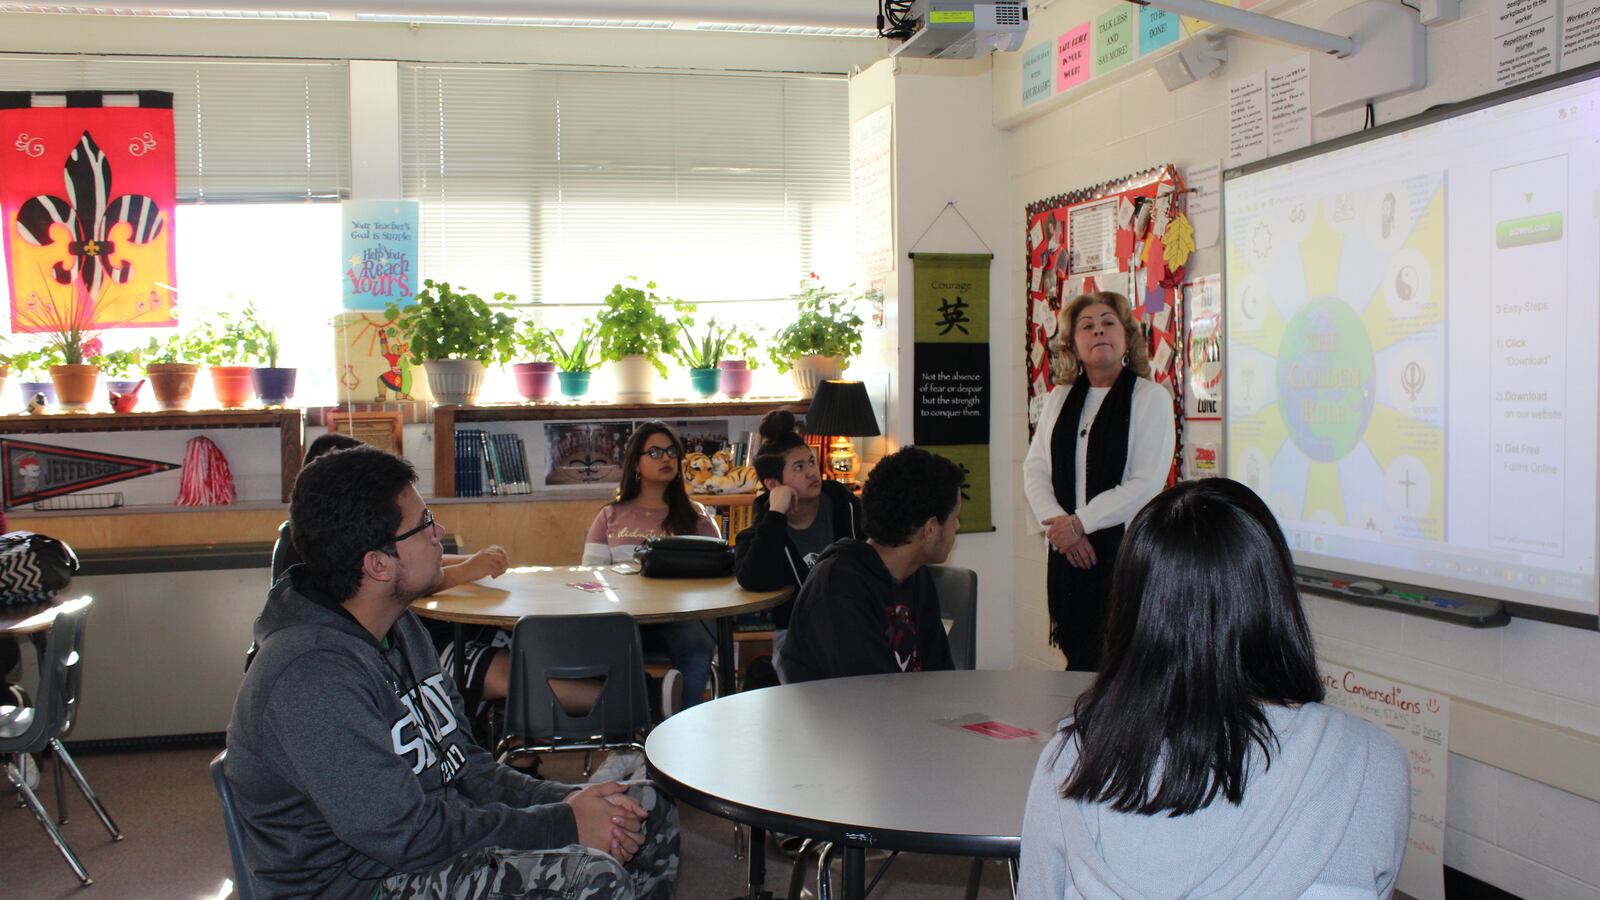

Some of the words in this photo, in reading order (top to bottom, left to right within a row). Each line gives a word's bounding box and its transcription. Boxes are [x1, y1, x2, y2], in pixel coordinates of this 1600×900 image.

[1150, 12, 1158, 22] TO
[1158, 8, 1167, 18] BE
[1515, 14, 1533, 24] worker
[1098, 21, 1113, 34] TALK
[1113, 12, 1128, 27] LESS
[1106, 33, 1119, 46] AND
[1098, 53, 1109, 65] SAY
[351, 231, 370, 239] Goal
[361, 256, 408, 279] Reach
[931, 280, 972, 293] Courage
[1503, 303, 1522, 315] Easy
[935, 296, 970, 336] 英
[1505, 338, 1526, 348] Click
[922, 373, 936, 381] Not
[937, 371, 950, 381] the
[951, 371, 980, 381] absence
[919, 383, 929, 392] of
[930, 383, 945, 392] fear
[956, 383, 983, 396] despair
[922, 395, 936, 405] but
[937, 395, 950, 405] the
[951, 395, 980, 407] strength
[1504, 391, 1547, 401] Download
[921, 408, 930, 416] to
[930, 409, 961, 419] conquer
[1504, 443, 1519, 454] Get
[1521, 443, 1540, 455] Free
[45, 459, 121, 485] JEFFERSON
[1530, 462, 1558, 475] Online
[1320, 675, 1338, 689] ure
